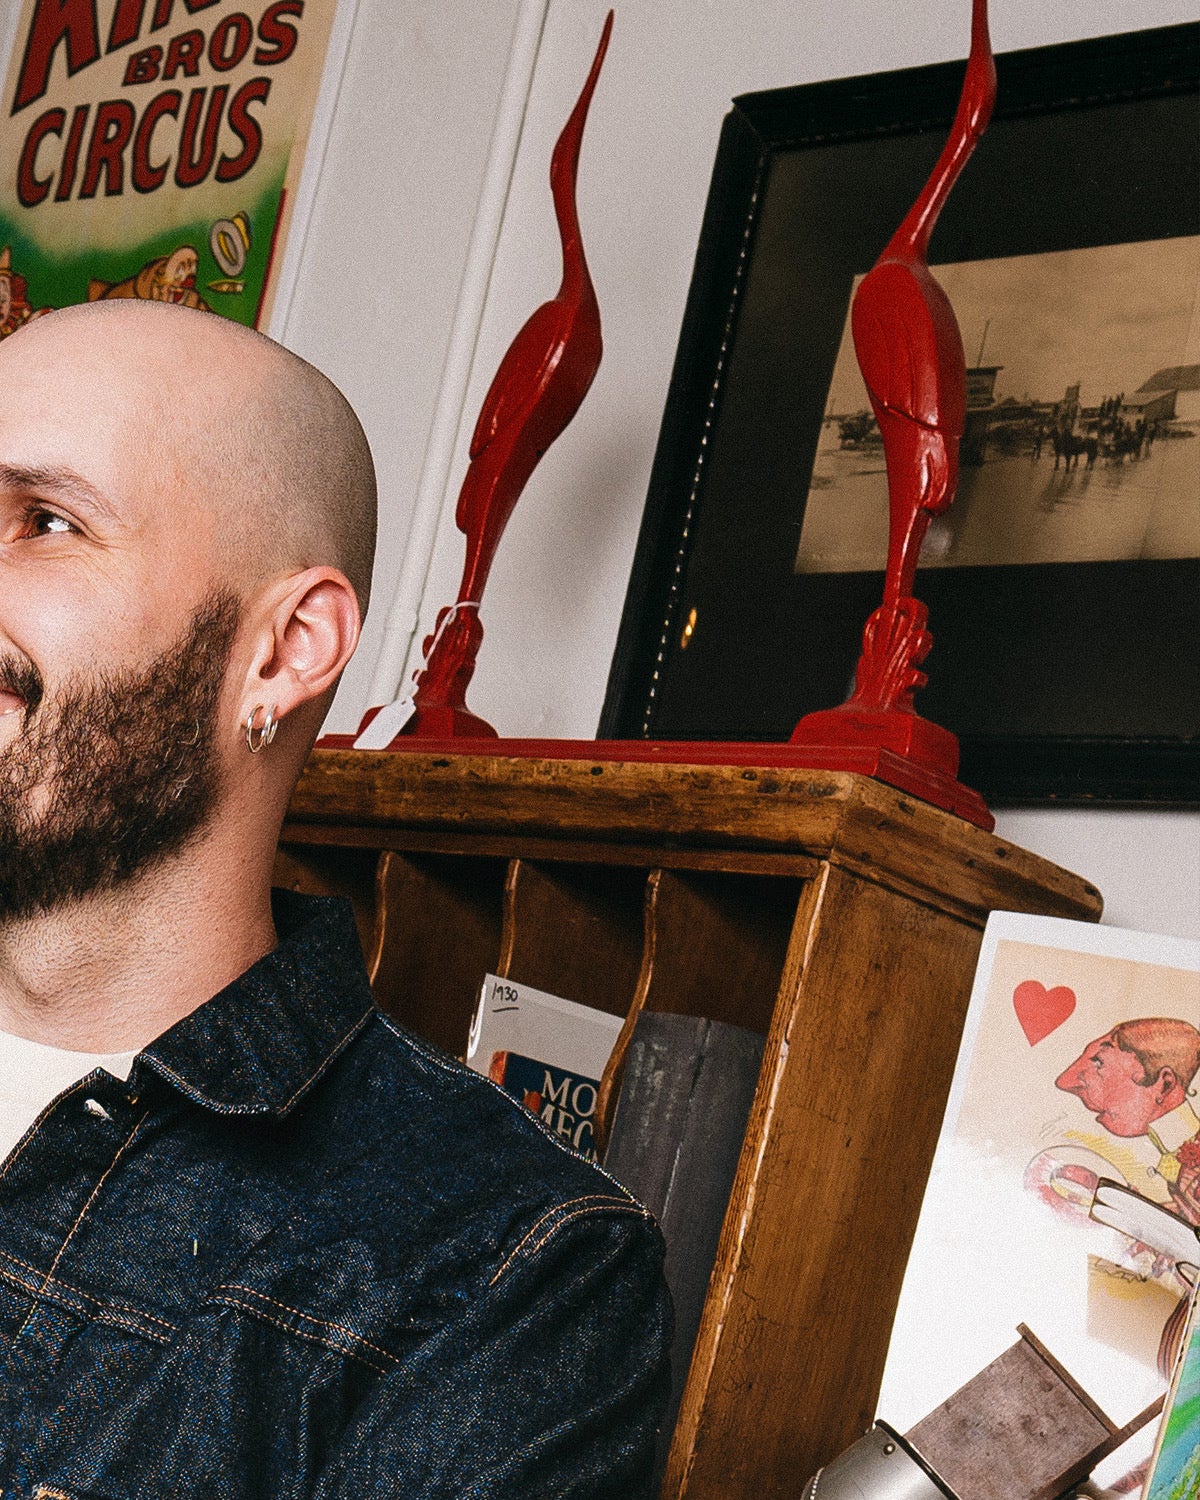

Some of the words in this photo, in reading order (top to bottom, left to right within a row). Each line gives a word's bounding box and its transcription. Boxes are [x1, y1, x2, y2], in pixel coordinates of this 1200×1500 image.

[121, 0, 304, 87] BROS
[16, 76, 272, 209] CIRCUS
[492, 983, 518, 1002] 1930
